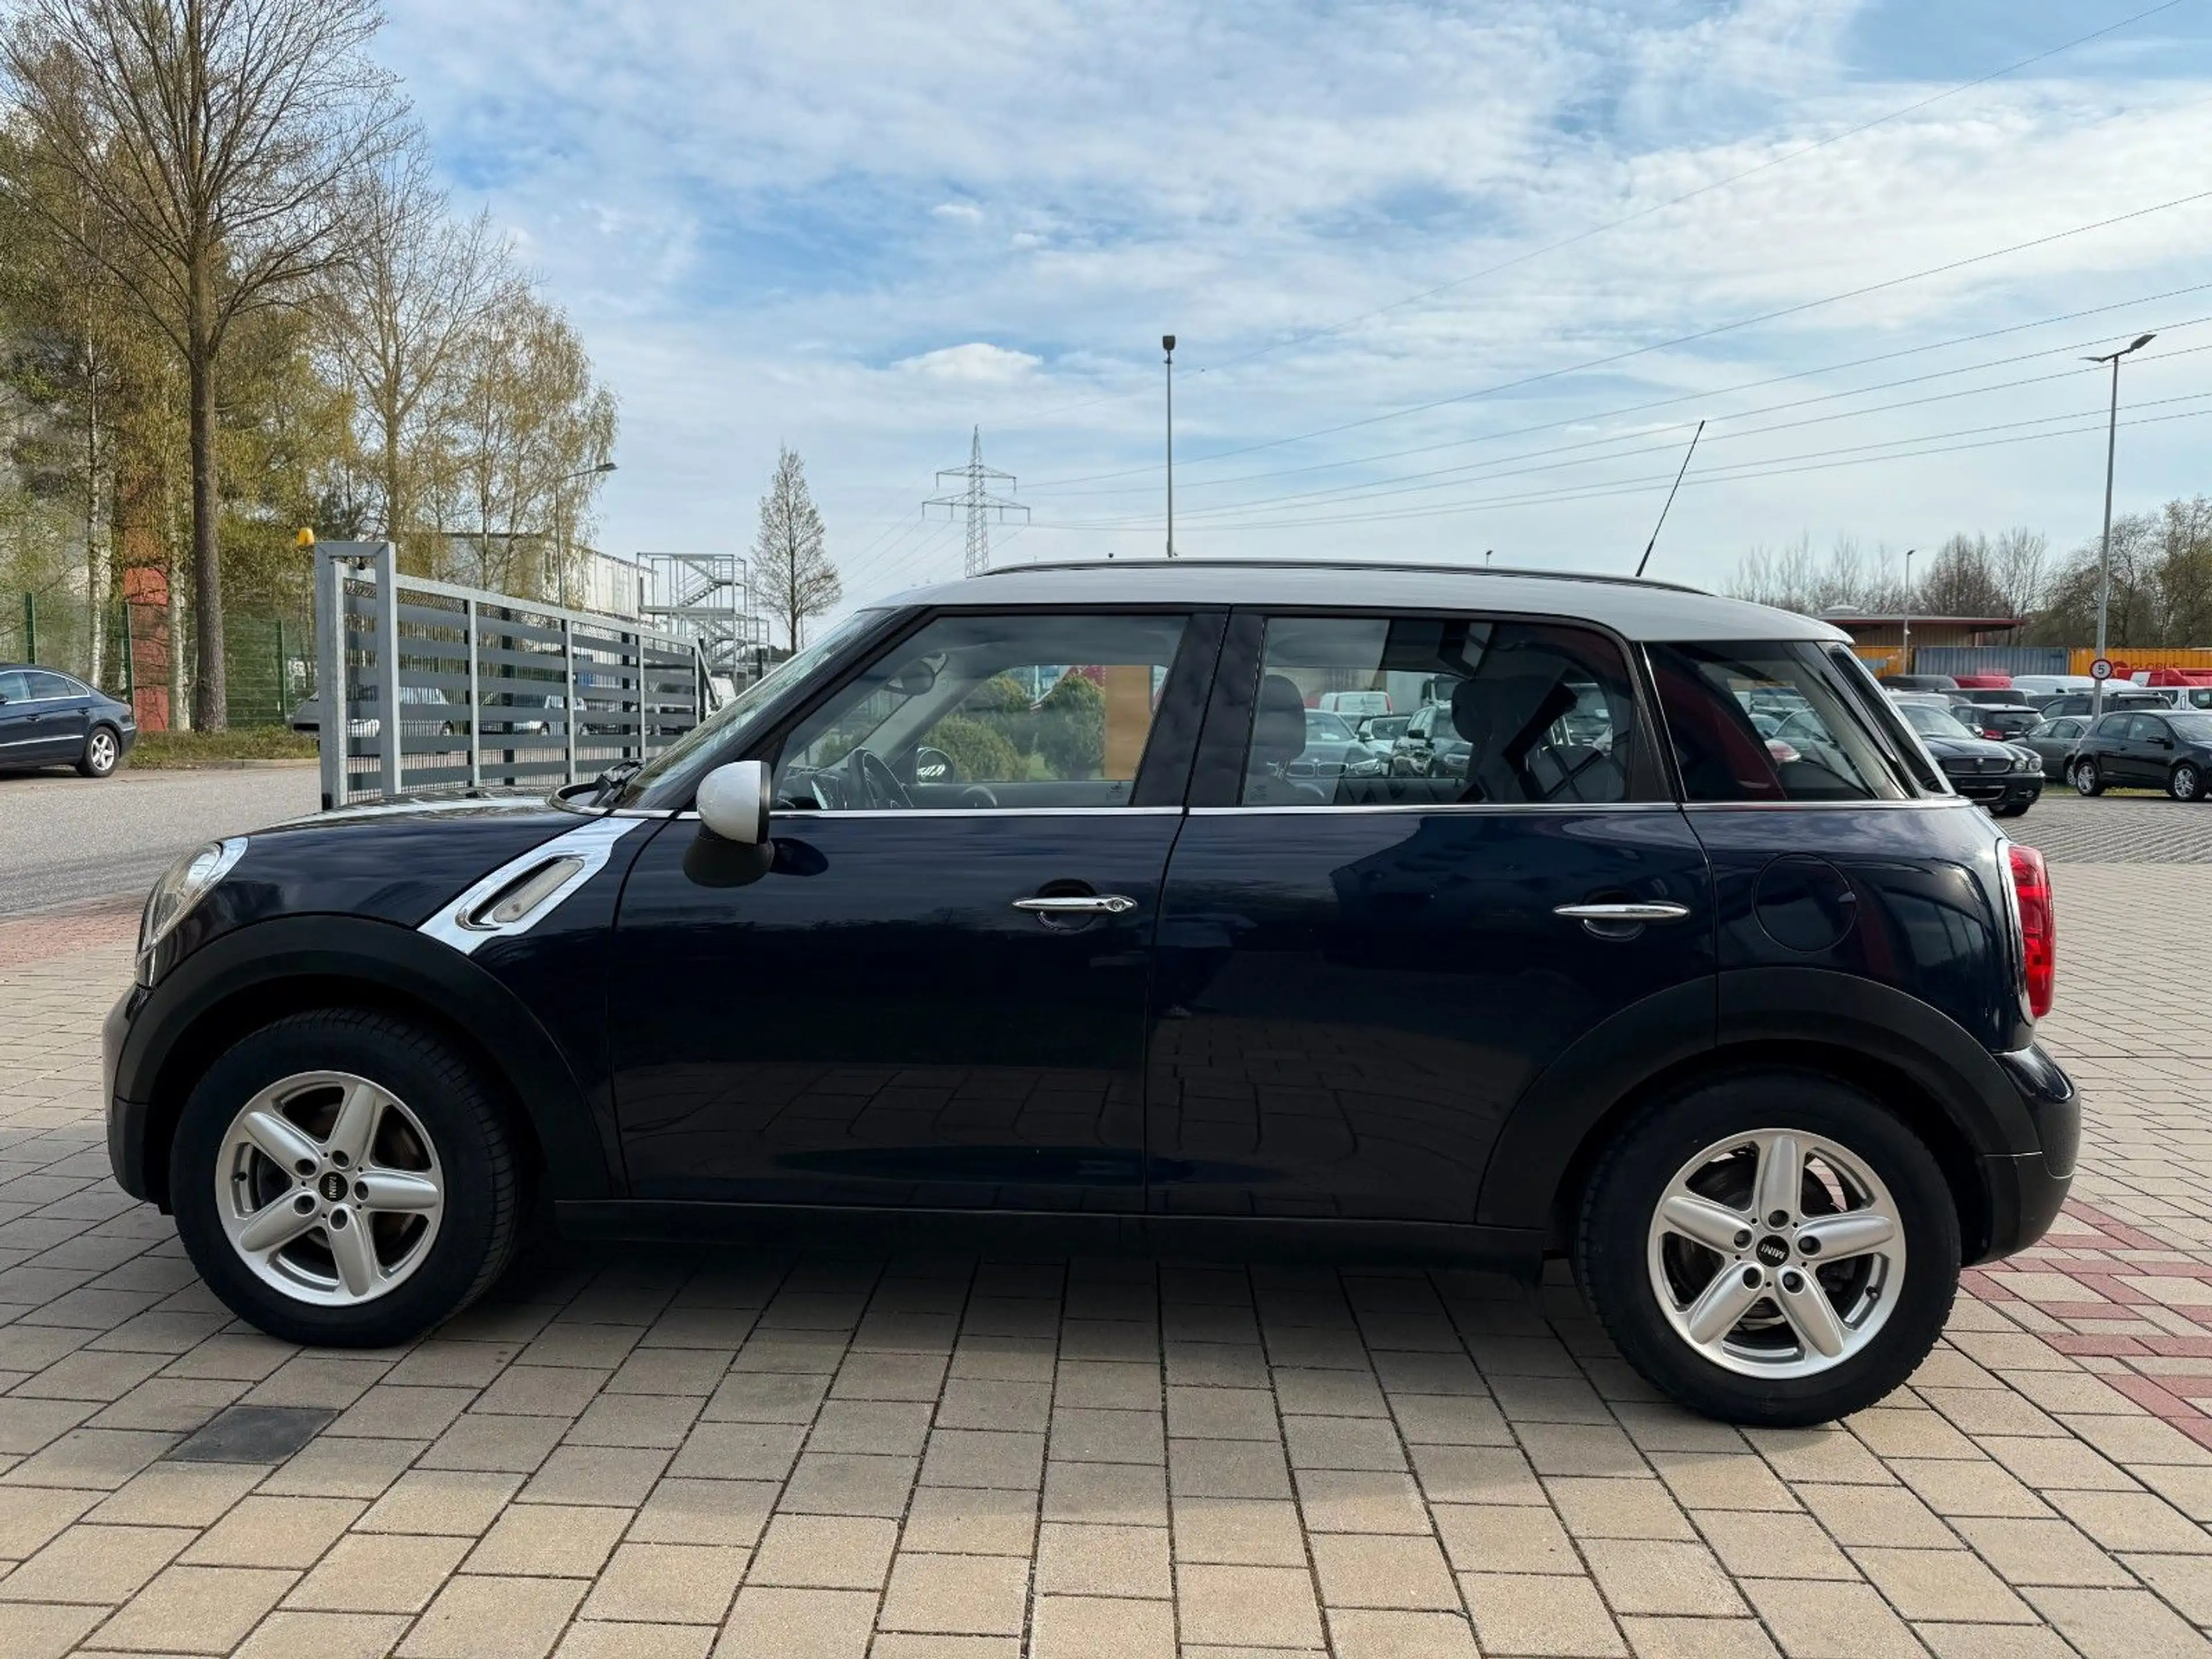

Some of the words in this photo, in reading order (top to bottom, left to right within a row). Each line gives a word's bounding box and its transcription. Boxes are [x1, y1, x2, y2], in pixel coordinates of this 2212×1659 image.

[2099, 665, 2105, 674] 5
[329, 1176, 337, 1198] MINI
[1761, 1244, 1786, 1259] MINI
